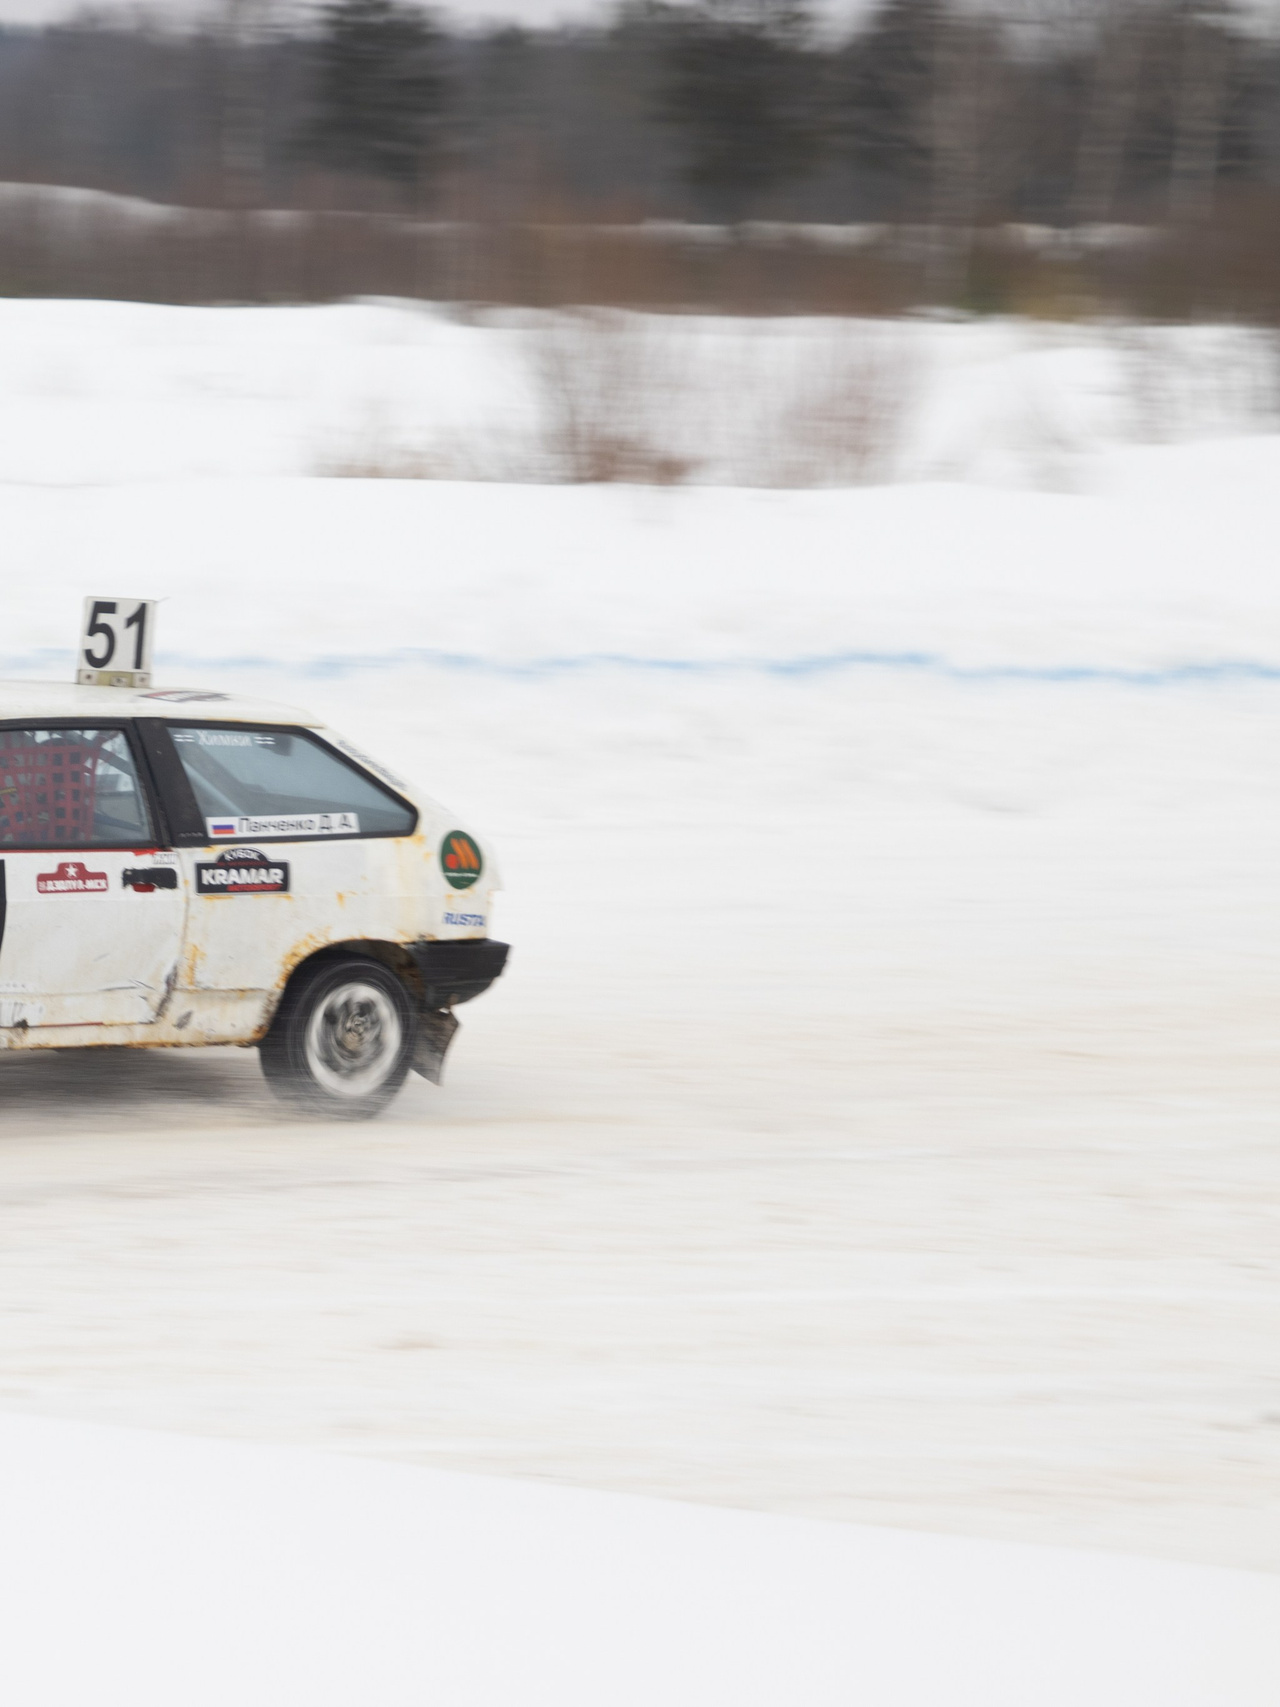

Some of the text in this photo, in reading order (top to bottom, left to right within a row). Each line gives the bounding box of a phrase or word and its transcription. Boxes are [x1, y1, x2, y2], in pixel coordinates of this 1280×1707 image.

[82, 600, 148, 670] 51
[238, 816, 317, 834] Панченко
[200, 867, 285, 886] KRAMAR
